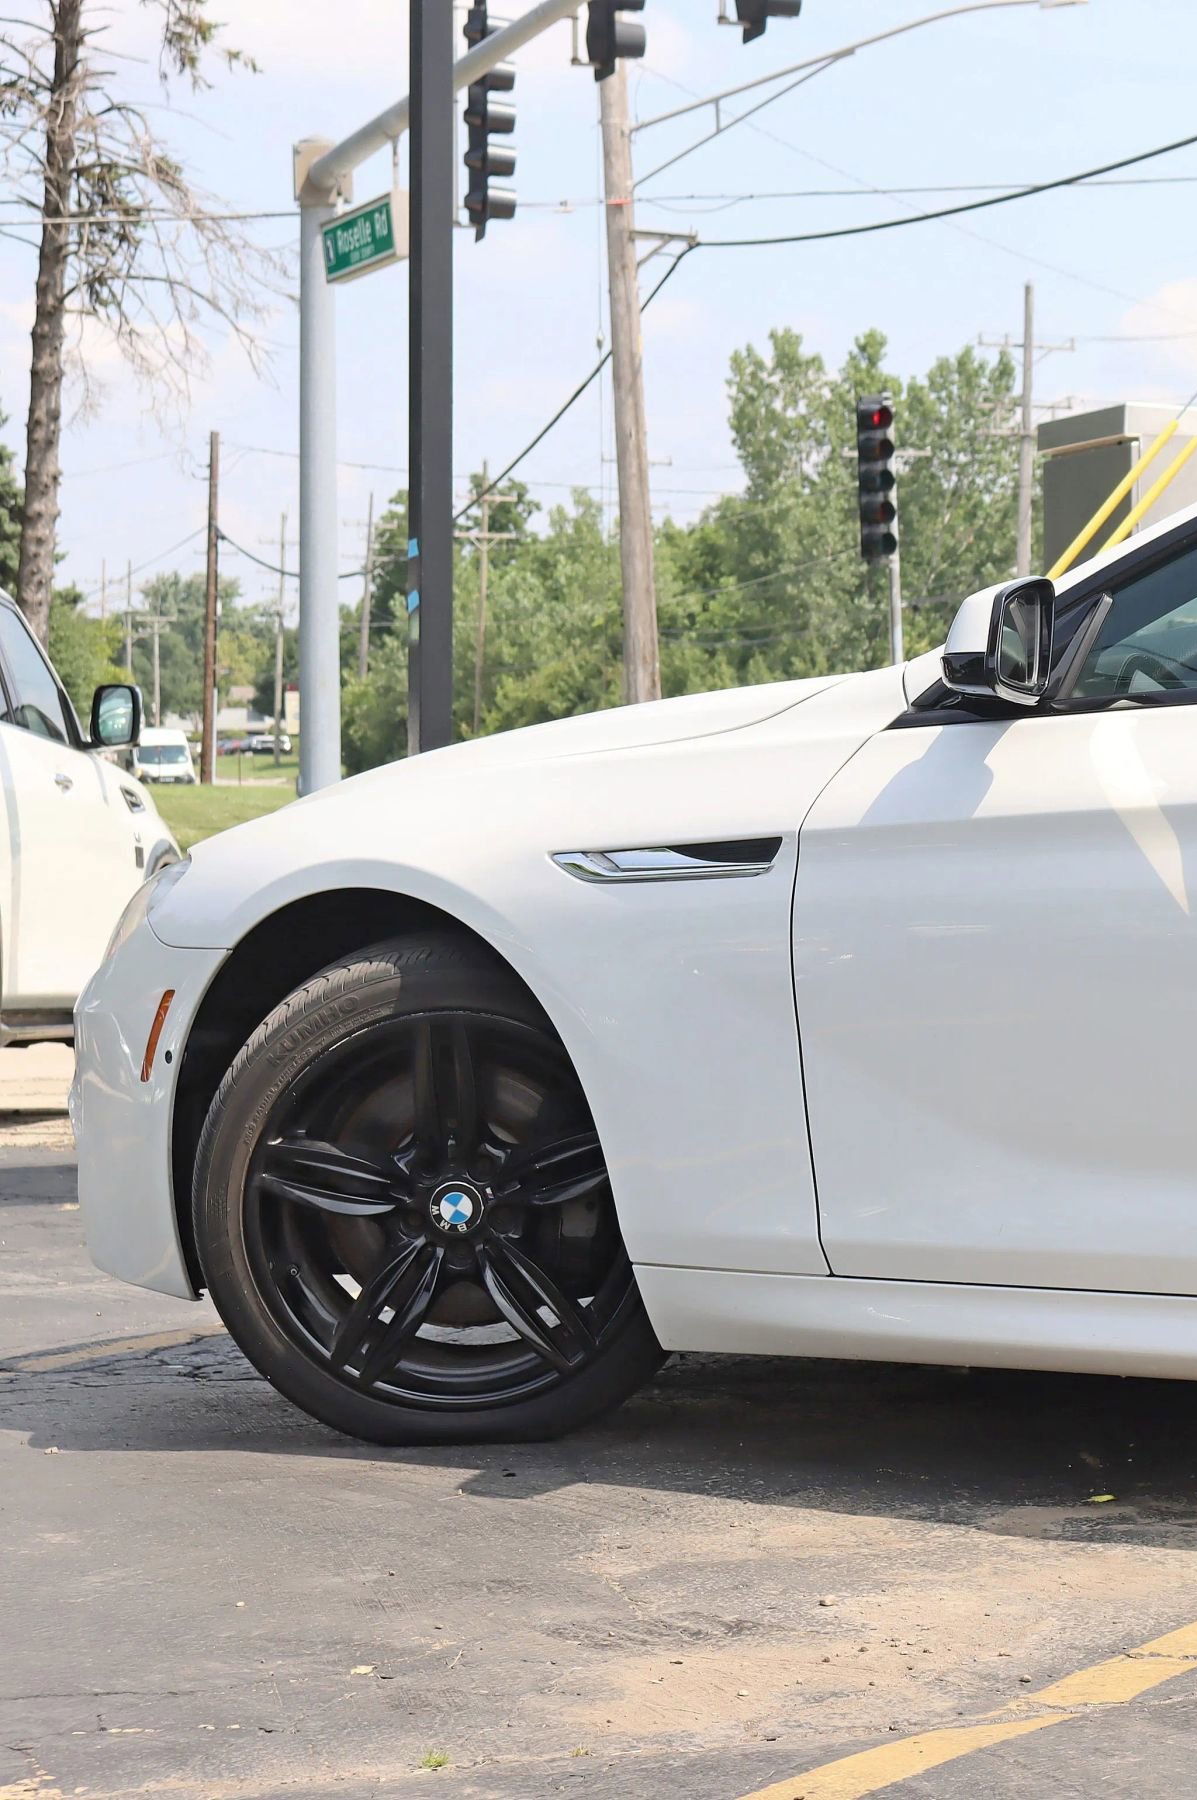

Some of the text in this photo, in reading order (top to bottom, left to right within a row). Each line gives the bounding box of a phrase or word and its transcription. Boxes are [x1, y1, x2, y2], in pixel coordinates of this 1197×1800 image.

[336, 217, 372, 255] Roselle
[374, 208, 388, 240] Rd
[266, 996, 361, 1069] KUMHO
[431, 1205, 468, 1233] BMW
